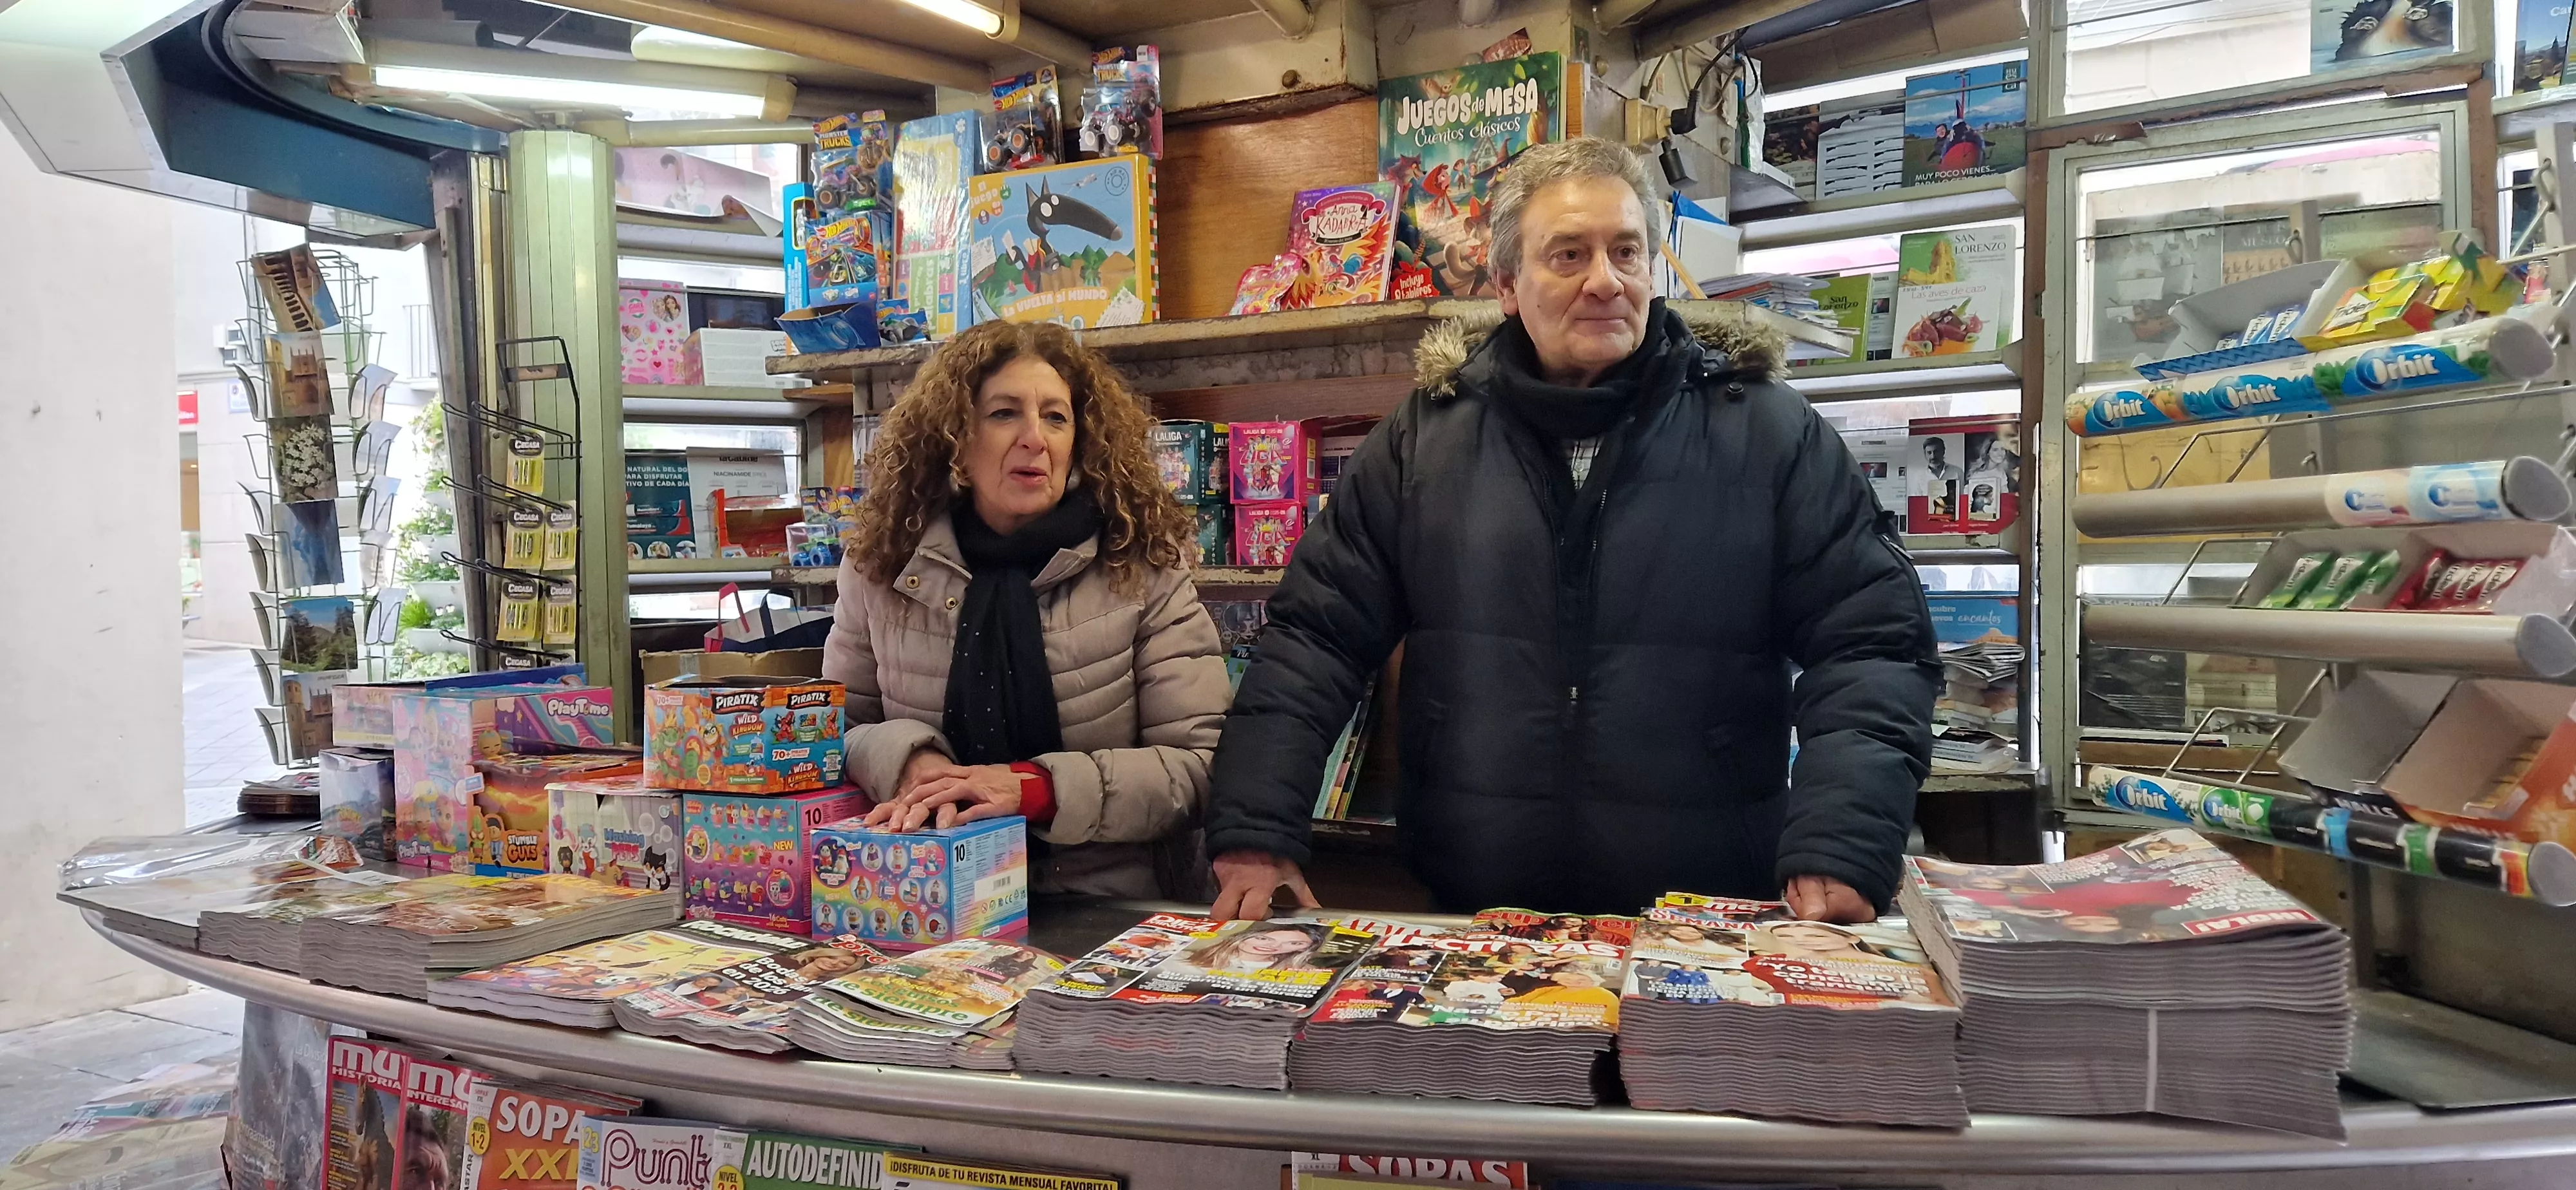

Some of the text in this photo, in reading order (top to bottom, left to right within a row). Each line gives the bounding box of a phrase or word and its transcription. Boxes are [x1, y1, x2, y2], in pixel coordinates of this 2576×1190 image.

[1397, 77, 1539, 135] JUEGOS de MESA
[1415, 117, 1521, 147] Cuentos clásicos
[819, 137, 852, 150] TRUCKS
[1915, 173, 1934, 181] MUY
[1935, 169, 1960, 178] POCO
[1331, 205, 1358, 216] Anna
[1955, 234, 1976, 243] SAN
[1955, 242, 2007, 255] LORENZO
[1399, 274, 1424, 290] Incluye
[1911, 291, 1927, 299] Las
[1965, 285, 1987, 294] caza
[1016, 294, 1054, 312] VUELTA
[1056, 293, 1065, 303] al
[1068, 288, 1108, 301] MUNDO
[1830, 296, 1848, 304] San
[2372, 352, 2440, 384] Orbit
[2228, 382, 2282, 410] Orbit
[2102, 399, 2146, 422] Orbit
[515, 438, 541, 450] CEGASA
[1155, 431, 1182, 442] LALIGA
[513, 512, 540, 523] CEGASA
[551, 511, 573, 522] CEGASA
[507, 582, 534, 594] CEGASA
[550, 585, 573, 597] CEGASA
[1958, 609, 2002, 625] encantos
[505, 656, 531, 668] CEGASA
[715, 693, 759, 709] PIRATIX
[791, 692, 826, 705] PIRATIX
[737, 713, 757, 724] WILD
[732, 723, 762, 736] KINGDOM
[772, 750, 791, 760] 70+
[792, 762, 813, 773] WILD
[2125, 784, 2168, 811] Orbit
[804, 807, 822, 826] 10
[2211, 800, 2242, 819] Orbit
[507, 835, 538, 845] STUMBLE
[773, 840, 794, 851] NEW
[507, 844, 538, 863] GUYS
[954, 844, 966, 863] 10
[1154, 914, 1218, 929] DIEZ
[1651, 909, 1759, 931] SEMANA
[739, 961, 786, 986] de los
[755, 957, 810, 985] Bodas
[1810, 967, 1927, 986] tengo la
[722, 967, 790, 995] en 2026
[860, 986, 969, 1021] siempre
[896, 985, 960, 1008] guisos
[332, 1066, 402, 1090] HISTORIA
[472, 1120, 486, 1133] NIVEL
[718, 1170, 738, 1184] NIVEL
[889, 1160, 936, 1178] ¡DISFRUTA
[938, 1167, 951, 1180] DE
[952, 1168, 965, 1180] TU
[967, 1169, 1008, 1185] REVISTA
[1009, 1175, 1059, 1190] MENSUAL
